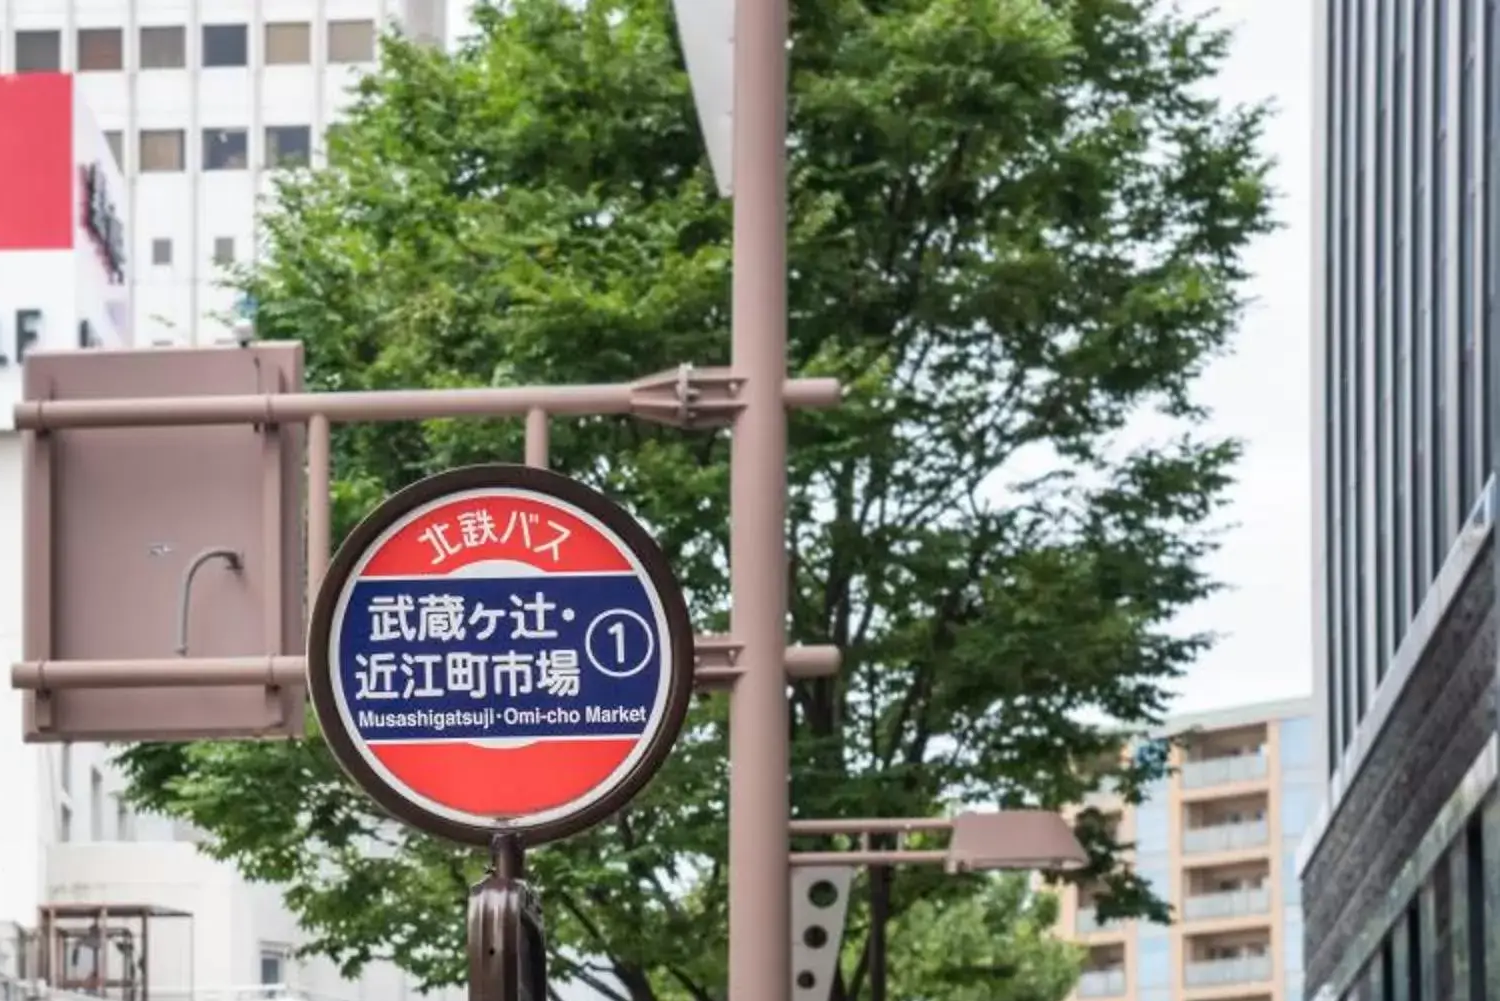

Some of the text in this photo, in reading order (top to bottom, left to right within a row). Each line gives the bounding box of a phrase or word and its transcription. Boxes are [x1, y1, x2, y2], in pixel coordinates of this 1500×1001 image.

[417, 508, 573, 565] 北鉄バス
[354, 650, 583, 701] 近江町市場
[585, 706, 647, 724] Market
